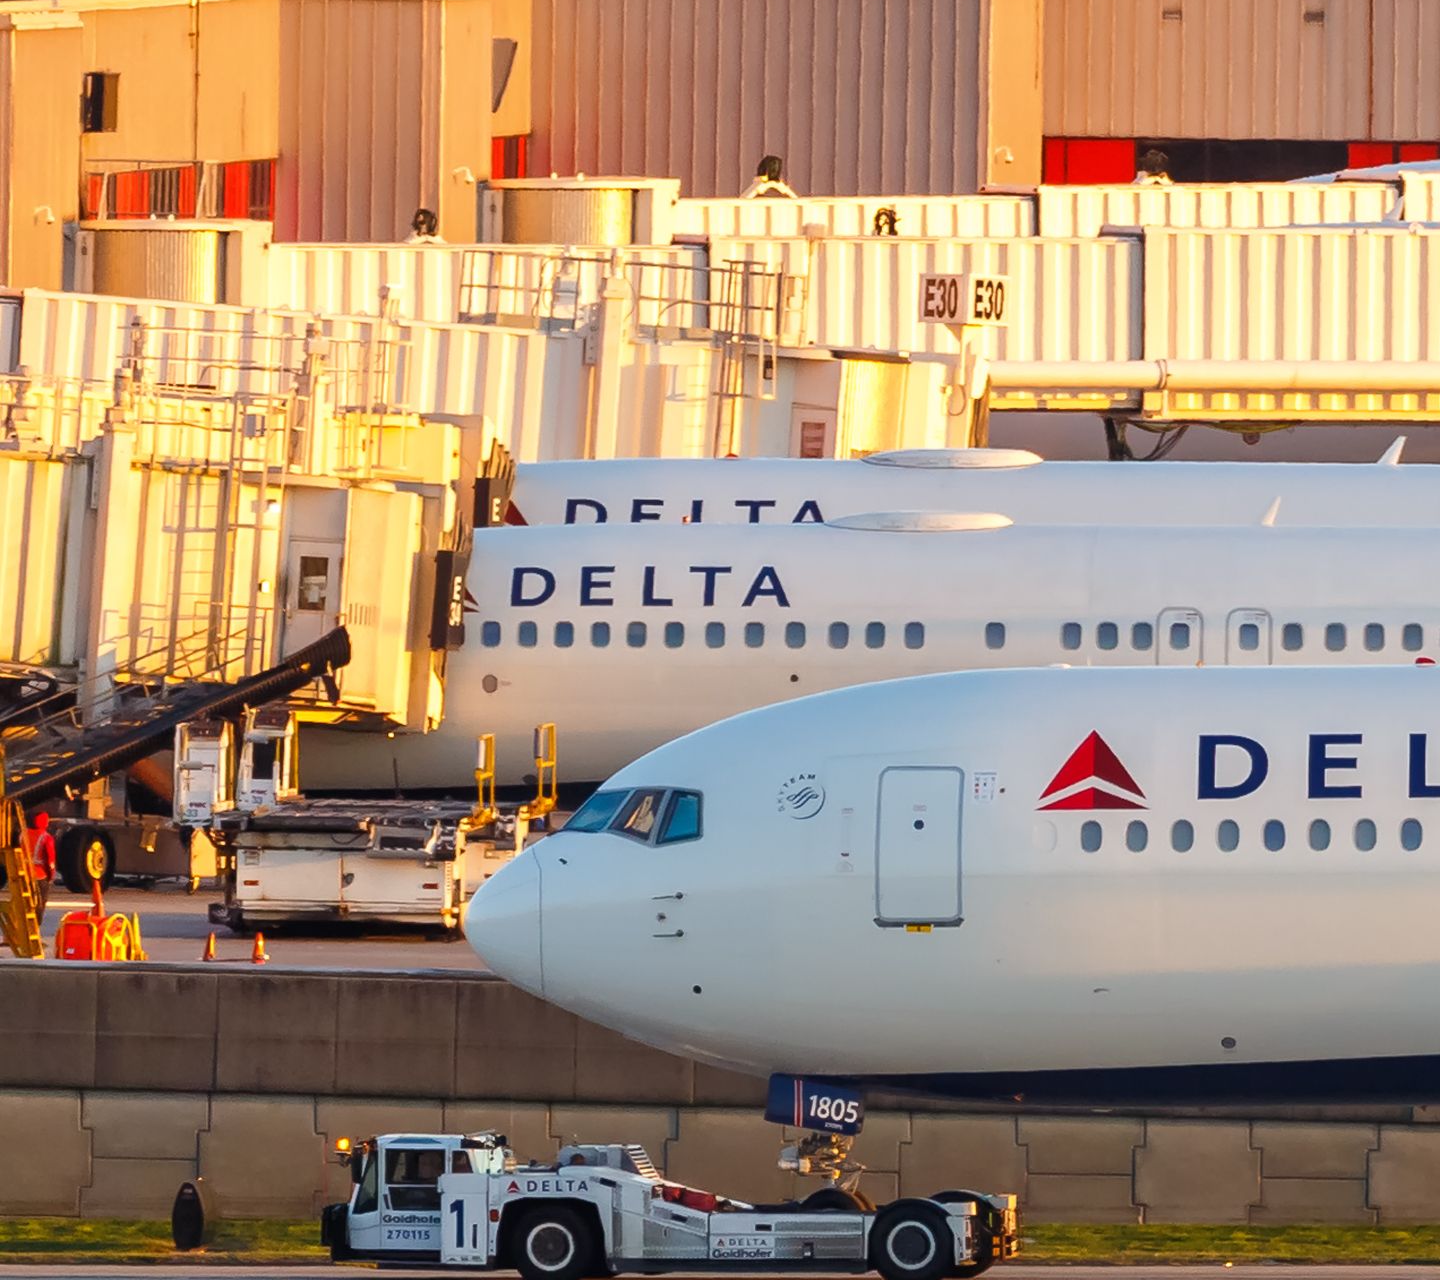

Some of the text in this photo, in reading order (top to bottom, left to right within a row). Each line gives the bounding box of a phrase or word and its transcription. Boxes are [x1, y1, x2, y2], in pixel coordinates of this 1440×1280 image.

[924, 278, 958, 318] E30
[974, 280, 1004, 320] E30
[511, 566, 791, 608] DELTA
[809, 1094, 860, 1124] 1805
[526, 1180, 589, 1193] DELTA
[382, 1214, 441, 1224] Goldhofe
[450, 1199, 465, 1248] 1
[387, 1229, 431, 1240] 270115
[712, 1249, 772, 1259] Goldhofer
